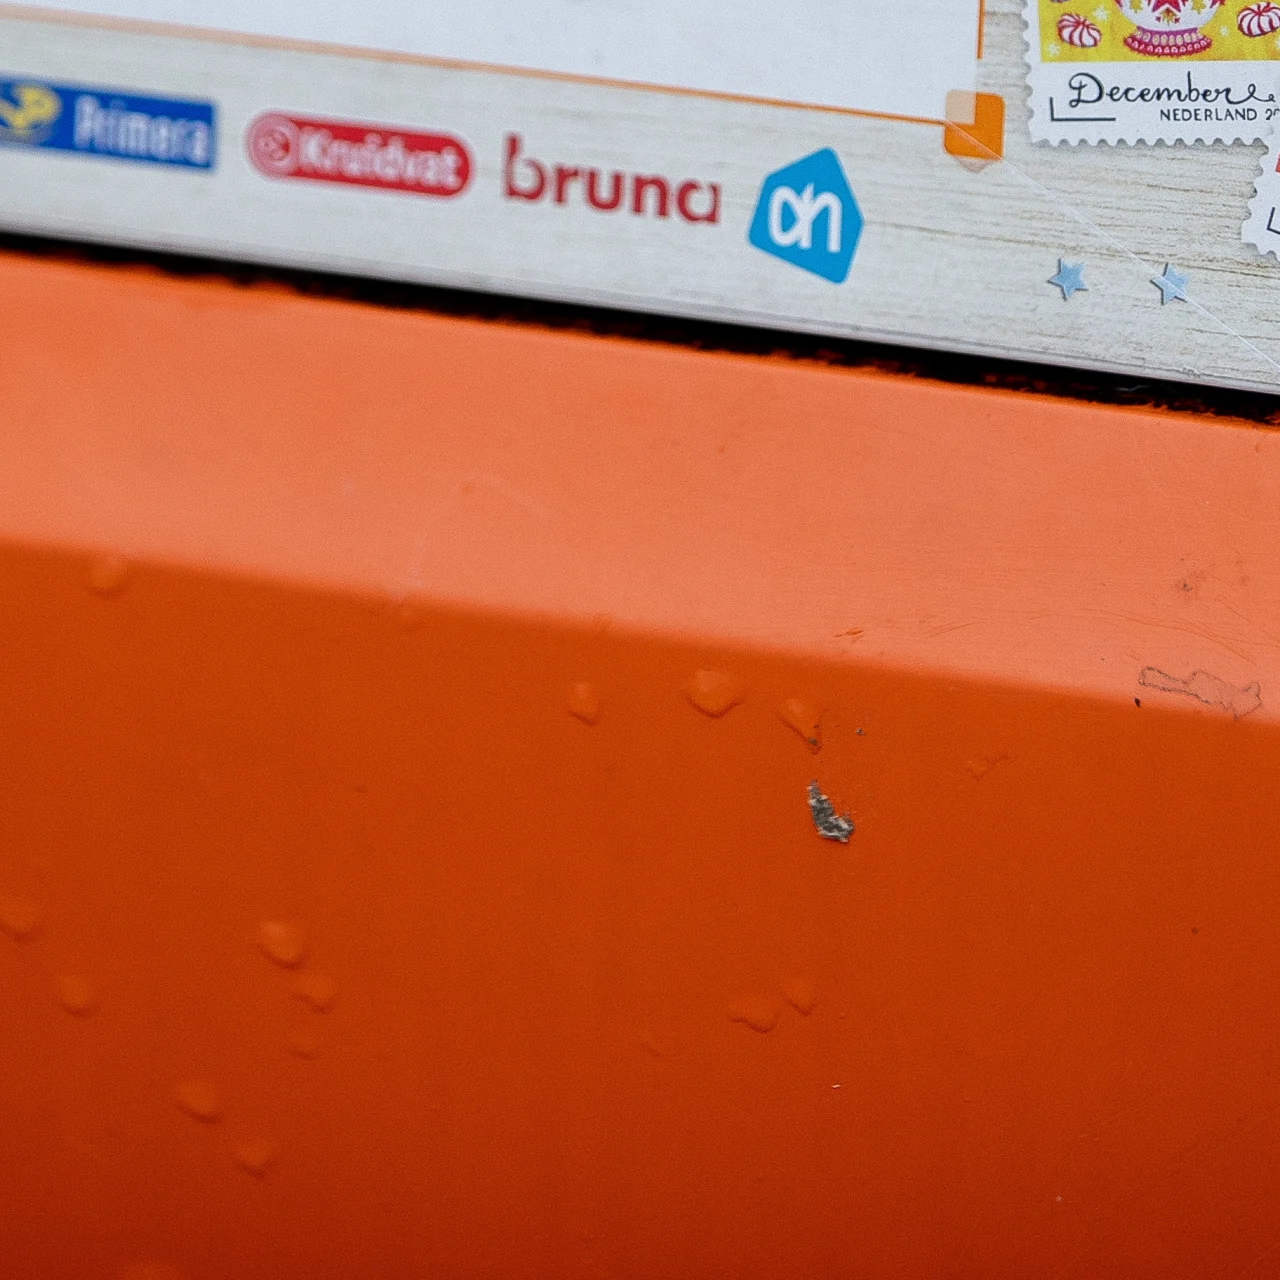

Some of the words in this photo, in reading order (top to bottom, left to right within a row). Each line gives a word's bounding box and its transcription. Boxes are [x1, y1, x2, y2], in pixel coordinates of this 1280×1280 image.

[1069, 71, 1275, 108] December
[1160, 107, 1257, 122] NEDERLAND
[299, 125, 463, 189] Kruidvat
[503, 131, 721, 225] bruna
